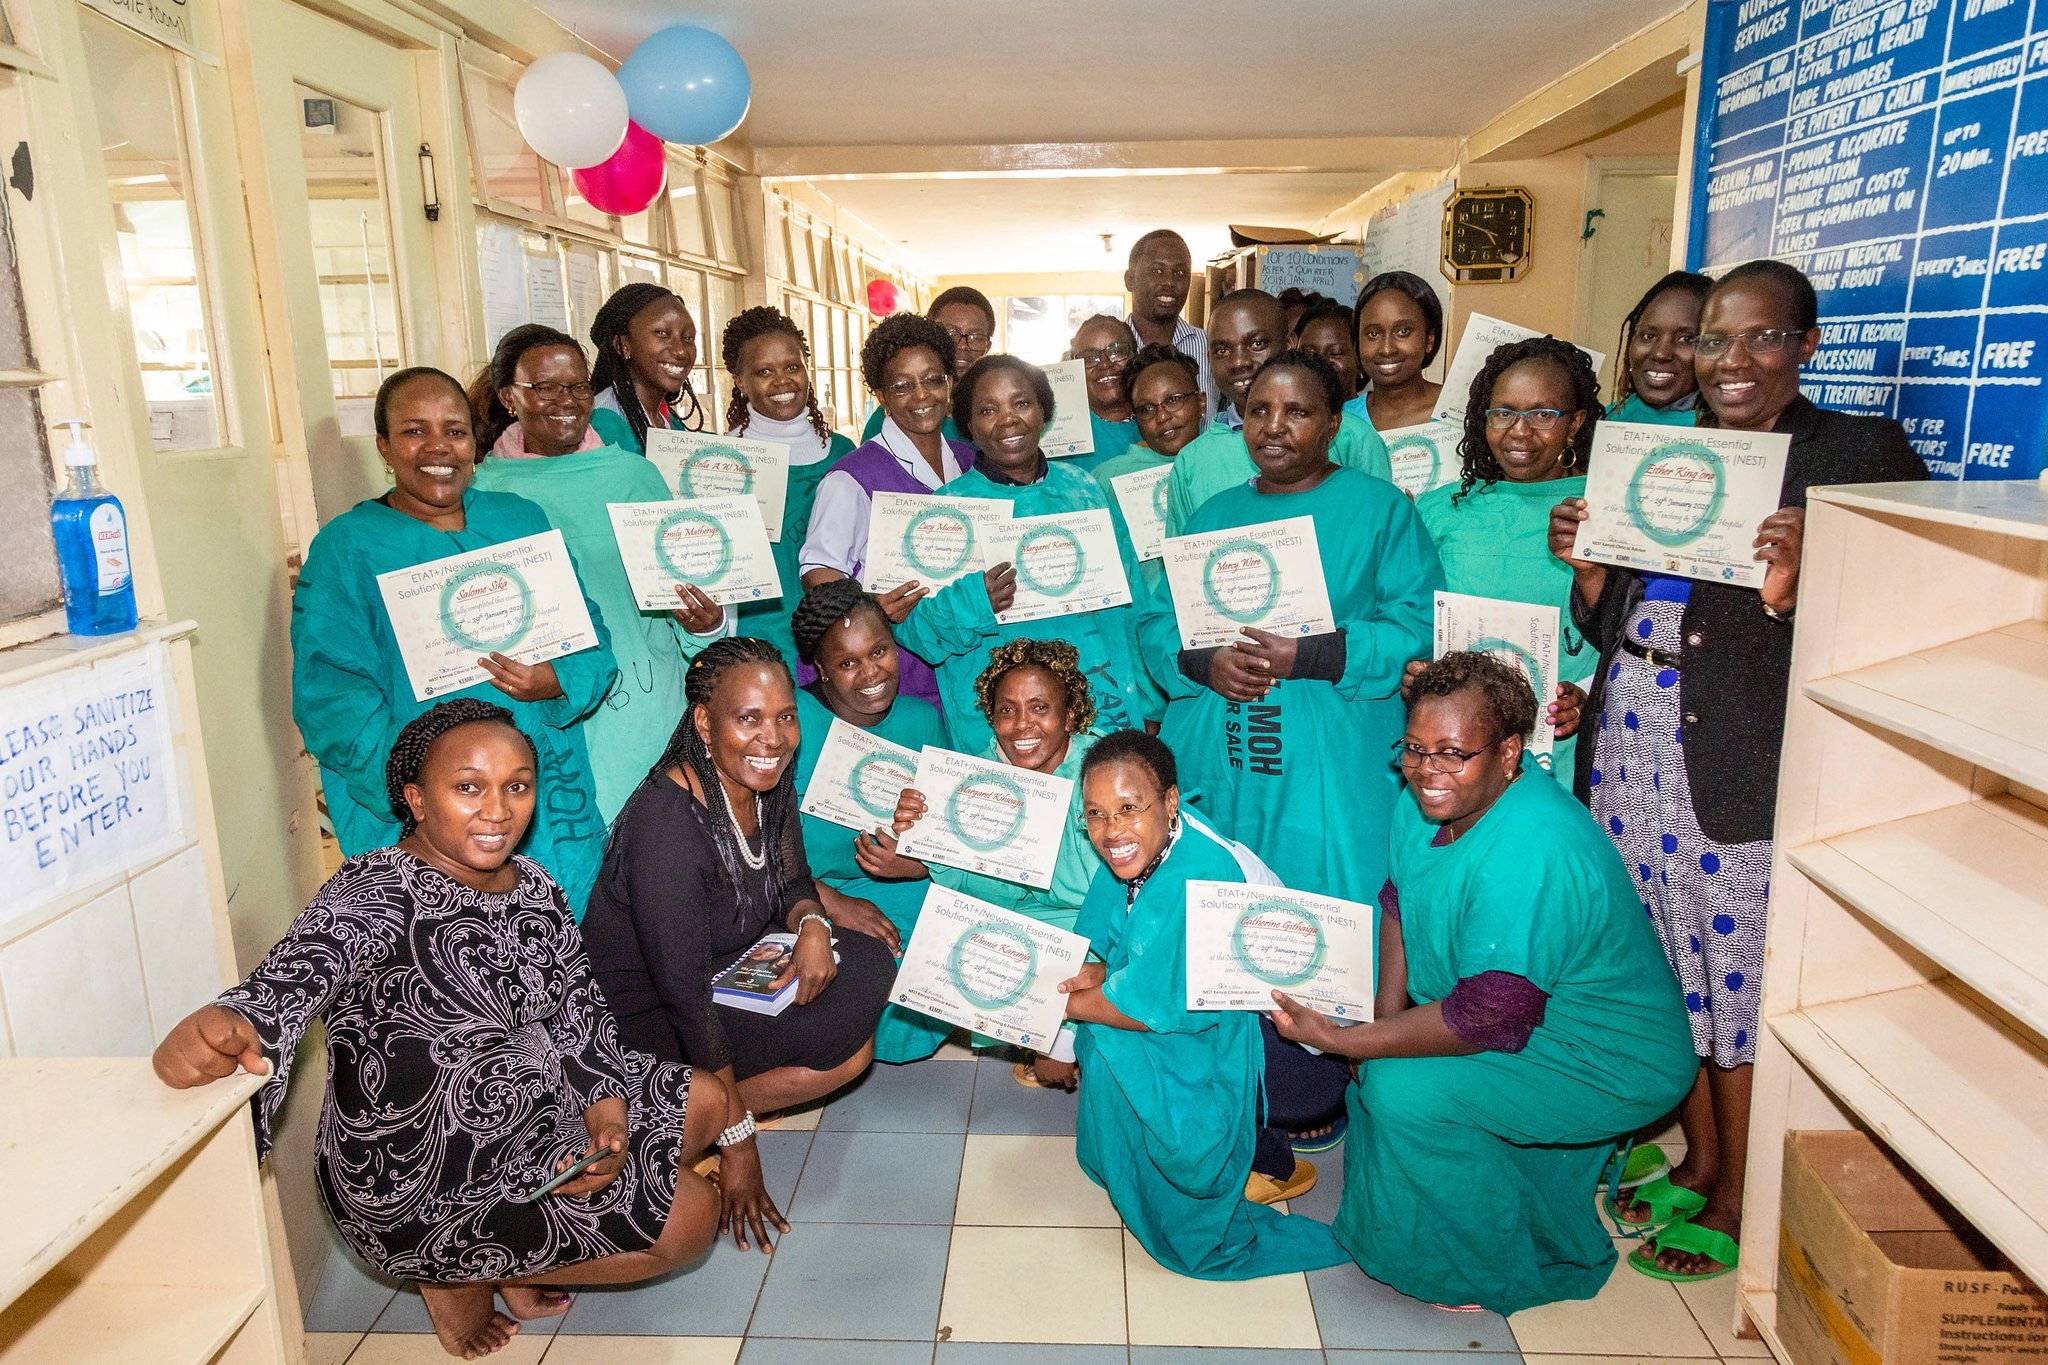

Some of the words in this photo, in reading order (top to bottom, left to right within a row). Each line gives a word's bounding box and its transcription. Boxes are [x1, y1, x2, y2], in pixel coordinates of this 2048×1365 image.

[1734, 6, 1790, 52] SERVICES
[1879, 2, 1907, 31] AND
[1797, 55, 1834, 86] ECTFUL
[1837, 48, 1851, 70] TO
[1853, 38, 1874, 63] ALL
[1877, 15, 1928, 54] HEALTH
[1792, 86, 1820, 113] CARE
[1824, 57, 1895, 102] PROVIDERS
[1808, 101, 1856, 136] PATIENT
[1856, 92, 1884, 120] AND
[1885, 78, 1926, 113] CALM
[1838, 120, 1909, 160] ACCURATE
[1784, 156, 1860, 194] INFORMATION
[1826, 177, 1865, 204] ABOUT
[1865, 167, 1911, 195] COSTS
[1510, 210, 1516, 220] 2
[1805, 195, 1891, 229] INFORMATION
[1895, 190, 1916, 212] ON
[1458, 229, 1464, 237] 9
[1510, 226, 1517, 235] 3
[1458, 244, 1466, 253] 8
[1471, 250, 1477, 260] 7
[1483, 251, 1489, 260] 6
[1776, 232, 1819, 255] ILLNESS
[1266, 251, 1285, 264] TOP
[1286, 252, 1301, 265] 10
[1302, 253, 1349, 265] CONDITIONS
[1814, 250, 1845, 272] WITH
[1847, 242, 1904, 266] MEDICAL
[1915, 257, 1955, 277] EVERY
[1993, 243, 2048, 275] FREE
[1272, 266, 1285, 275] PER
[1841, 265, 1887, 290] ABOUT
[1809, 348, 1877, 371] POCESSION
[1982, 340, 2036, 369] FREE
[1824, 384, 1893, 406] TREATMENT
[1920, 418, 1945, 436] PER
[1605, 443, 1648, 456] Solutions
[1650, 448, 1657, 457] &
[1660, 449, 1730, 463] Technologies
[1733, 454, 1767, 468] (NEST)
[1707, 438, 1752, 451] Essential
[1966, 442, 2014, 468] FREE
[1250, 527, 1286, 541] Essential
[492, 544, 534, 562] Essential
[1174, 551, 1208, 563] Solutions
[1275, 537, 1302, 550] (NEST)
[398, 580, 444, 600] Solutions
[445, 577, 453, 586] &
[455, 560, 521, 585] Technologies
[523, 551, 552, 568] (NEST)
[456, 584, 488, 602] Salome
[74, 688, 155, 737] SANITIZE
[1226, 721, 1243, 771] SALE
[4, 755, 57, 801] OUR
[68, 723, 138, 772] HANDS
[929, 764, 966, 777] Solutions
[1032, 786, 1058, 802] (NEST)
[1011, 771, 1047, 788] Essential
[4, 773, 105, 843] BEFORE
[113, 756, 151, 792] YOU
[35, 794, 143, 871] ENTER.
[1217, 889, 1298, 904] ETAT+/Newborn
[1300, 898, 1341, 913] Essential
[1201, 900, 1244, 911] Solutions
[1248, 903, 1255, 911] &
[1258, 904, 1324, 922] Technologies
[1327, 917, 1356, 930] (NEST)
[1240, 916, 1281, 930] Catherine
[935, 906, 975, 925] Solutions
[975, 920, 983, 928] &
[985, 922, 1044, 951] Technologies
[1045, 944, 1072, 961] (NEST)
[969, 933, 999, 950] Winnie
[1025, 924, 1062, 943] Essential
[1941, 1312, 2048, 1328] SUPPLEMENTA
[1940, 1328, 2024, 1342] Instructions
